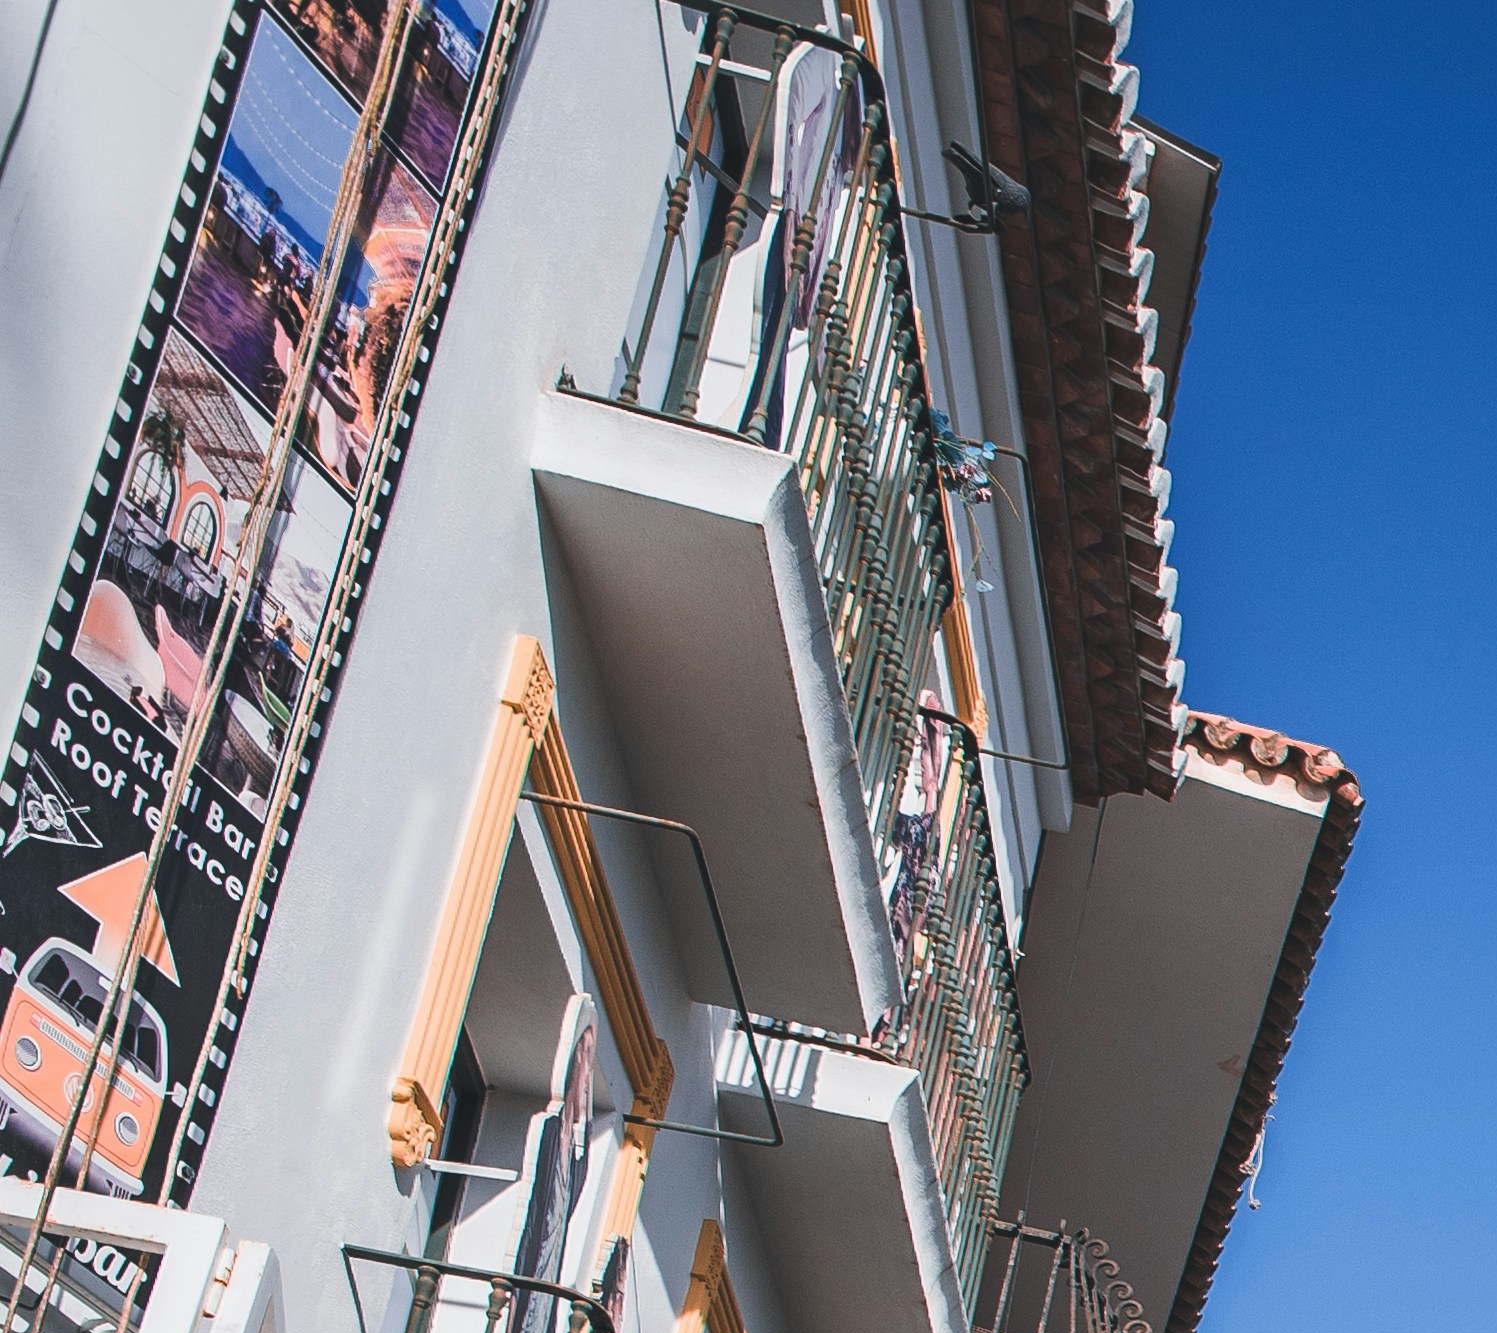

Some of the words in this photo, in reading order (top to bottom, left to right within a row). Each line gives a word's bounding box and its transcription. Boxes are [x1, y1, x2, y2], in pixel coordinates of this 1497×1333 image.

[51, 718, 127, 798] Roof
[132, 785, 244, 901] Terrace
[67, 683, 202, 812] Cocktail
[206, 801, 255, 860] Bar
